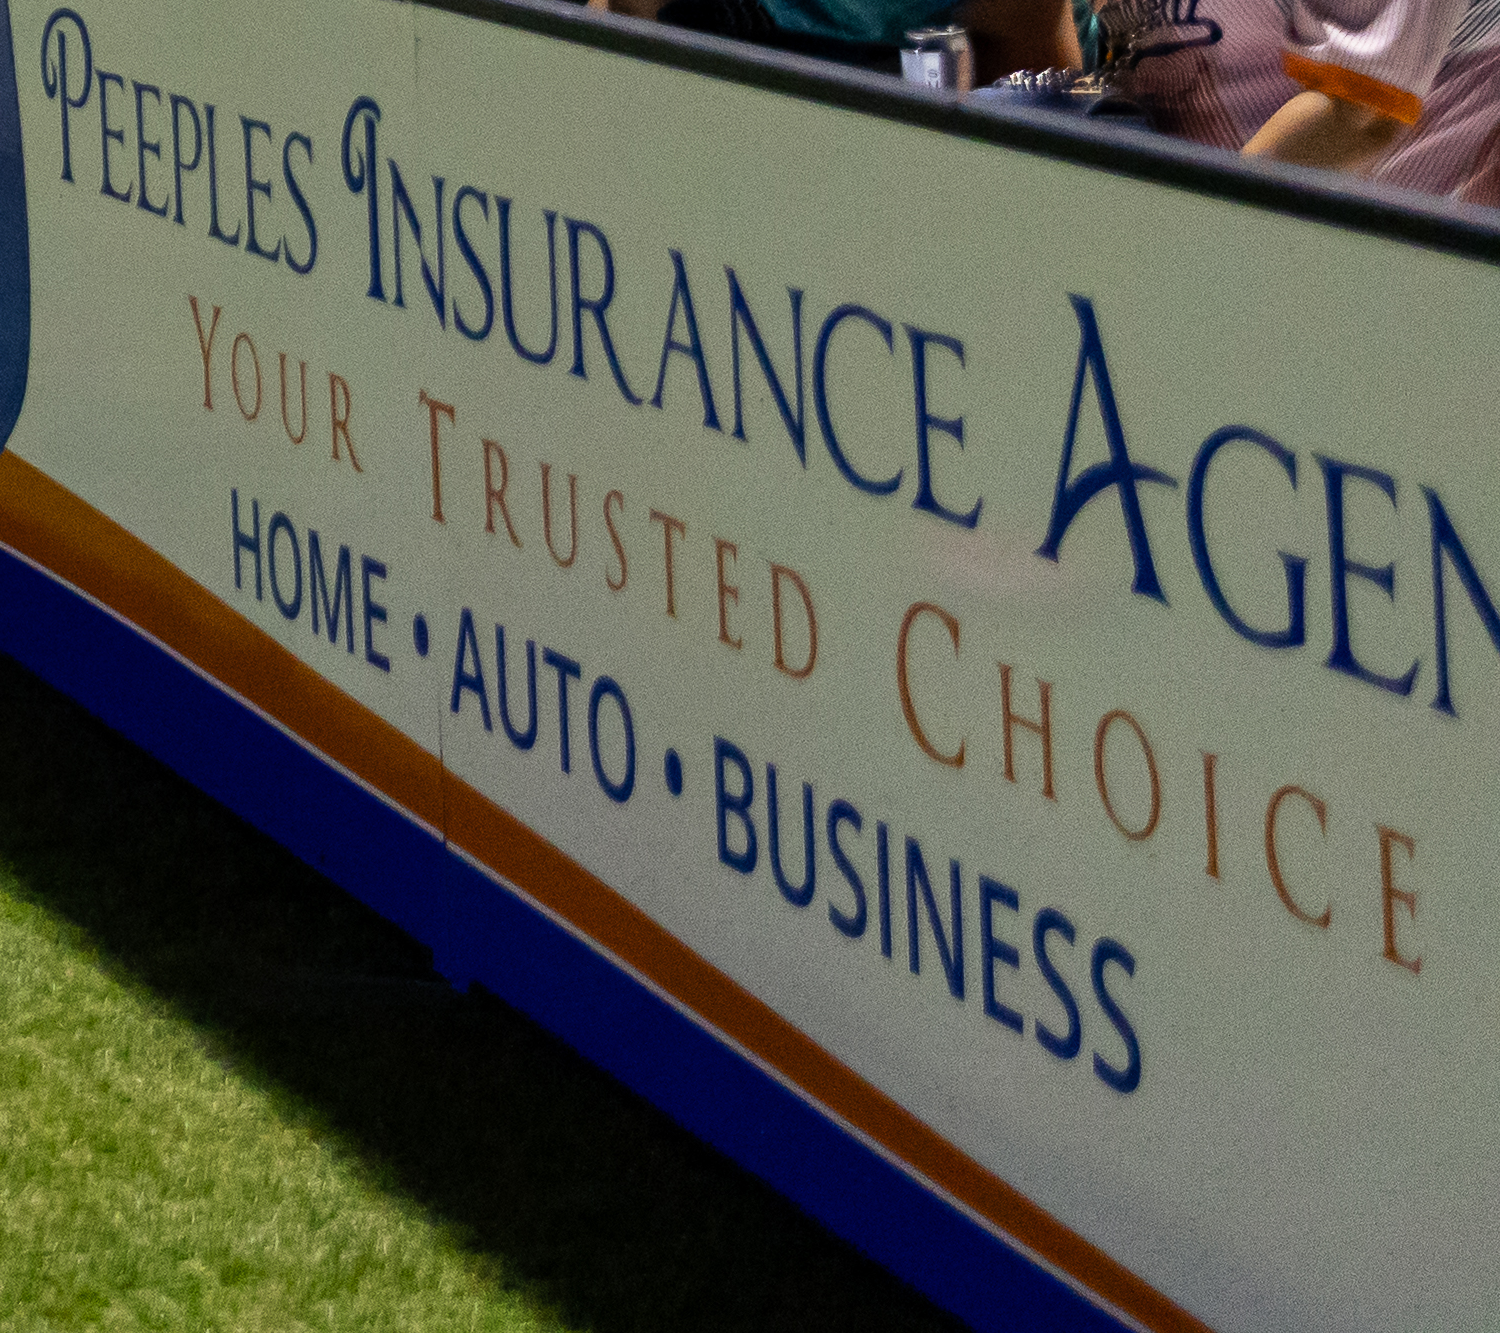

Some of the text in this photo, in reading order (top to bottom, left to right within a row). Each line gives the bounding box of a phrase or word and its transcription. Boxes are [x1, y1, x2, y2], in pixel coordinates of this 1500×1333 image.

[40, 7, 319, 276] PEEPLES
[340, 95, 984, 530] INSURANCE
[188, 294, 1423, 976] YOUR TRUSTED CHOICE
[230, 487, 1142, 1095] HOME AUTO BUSINESS
